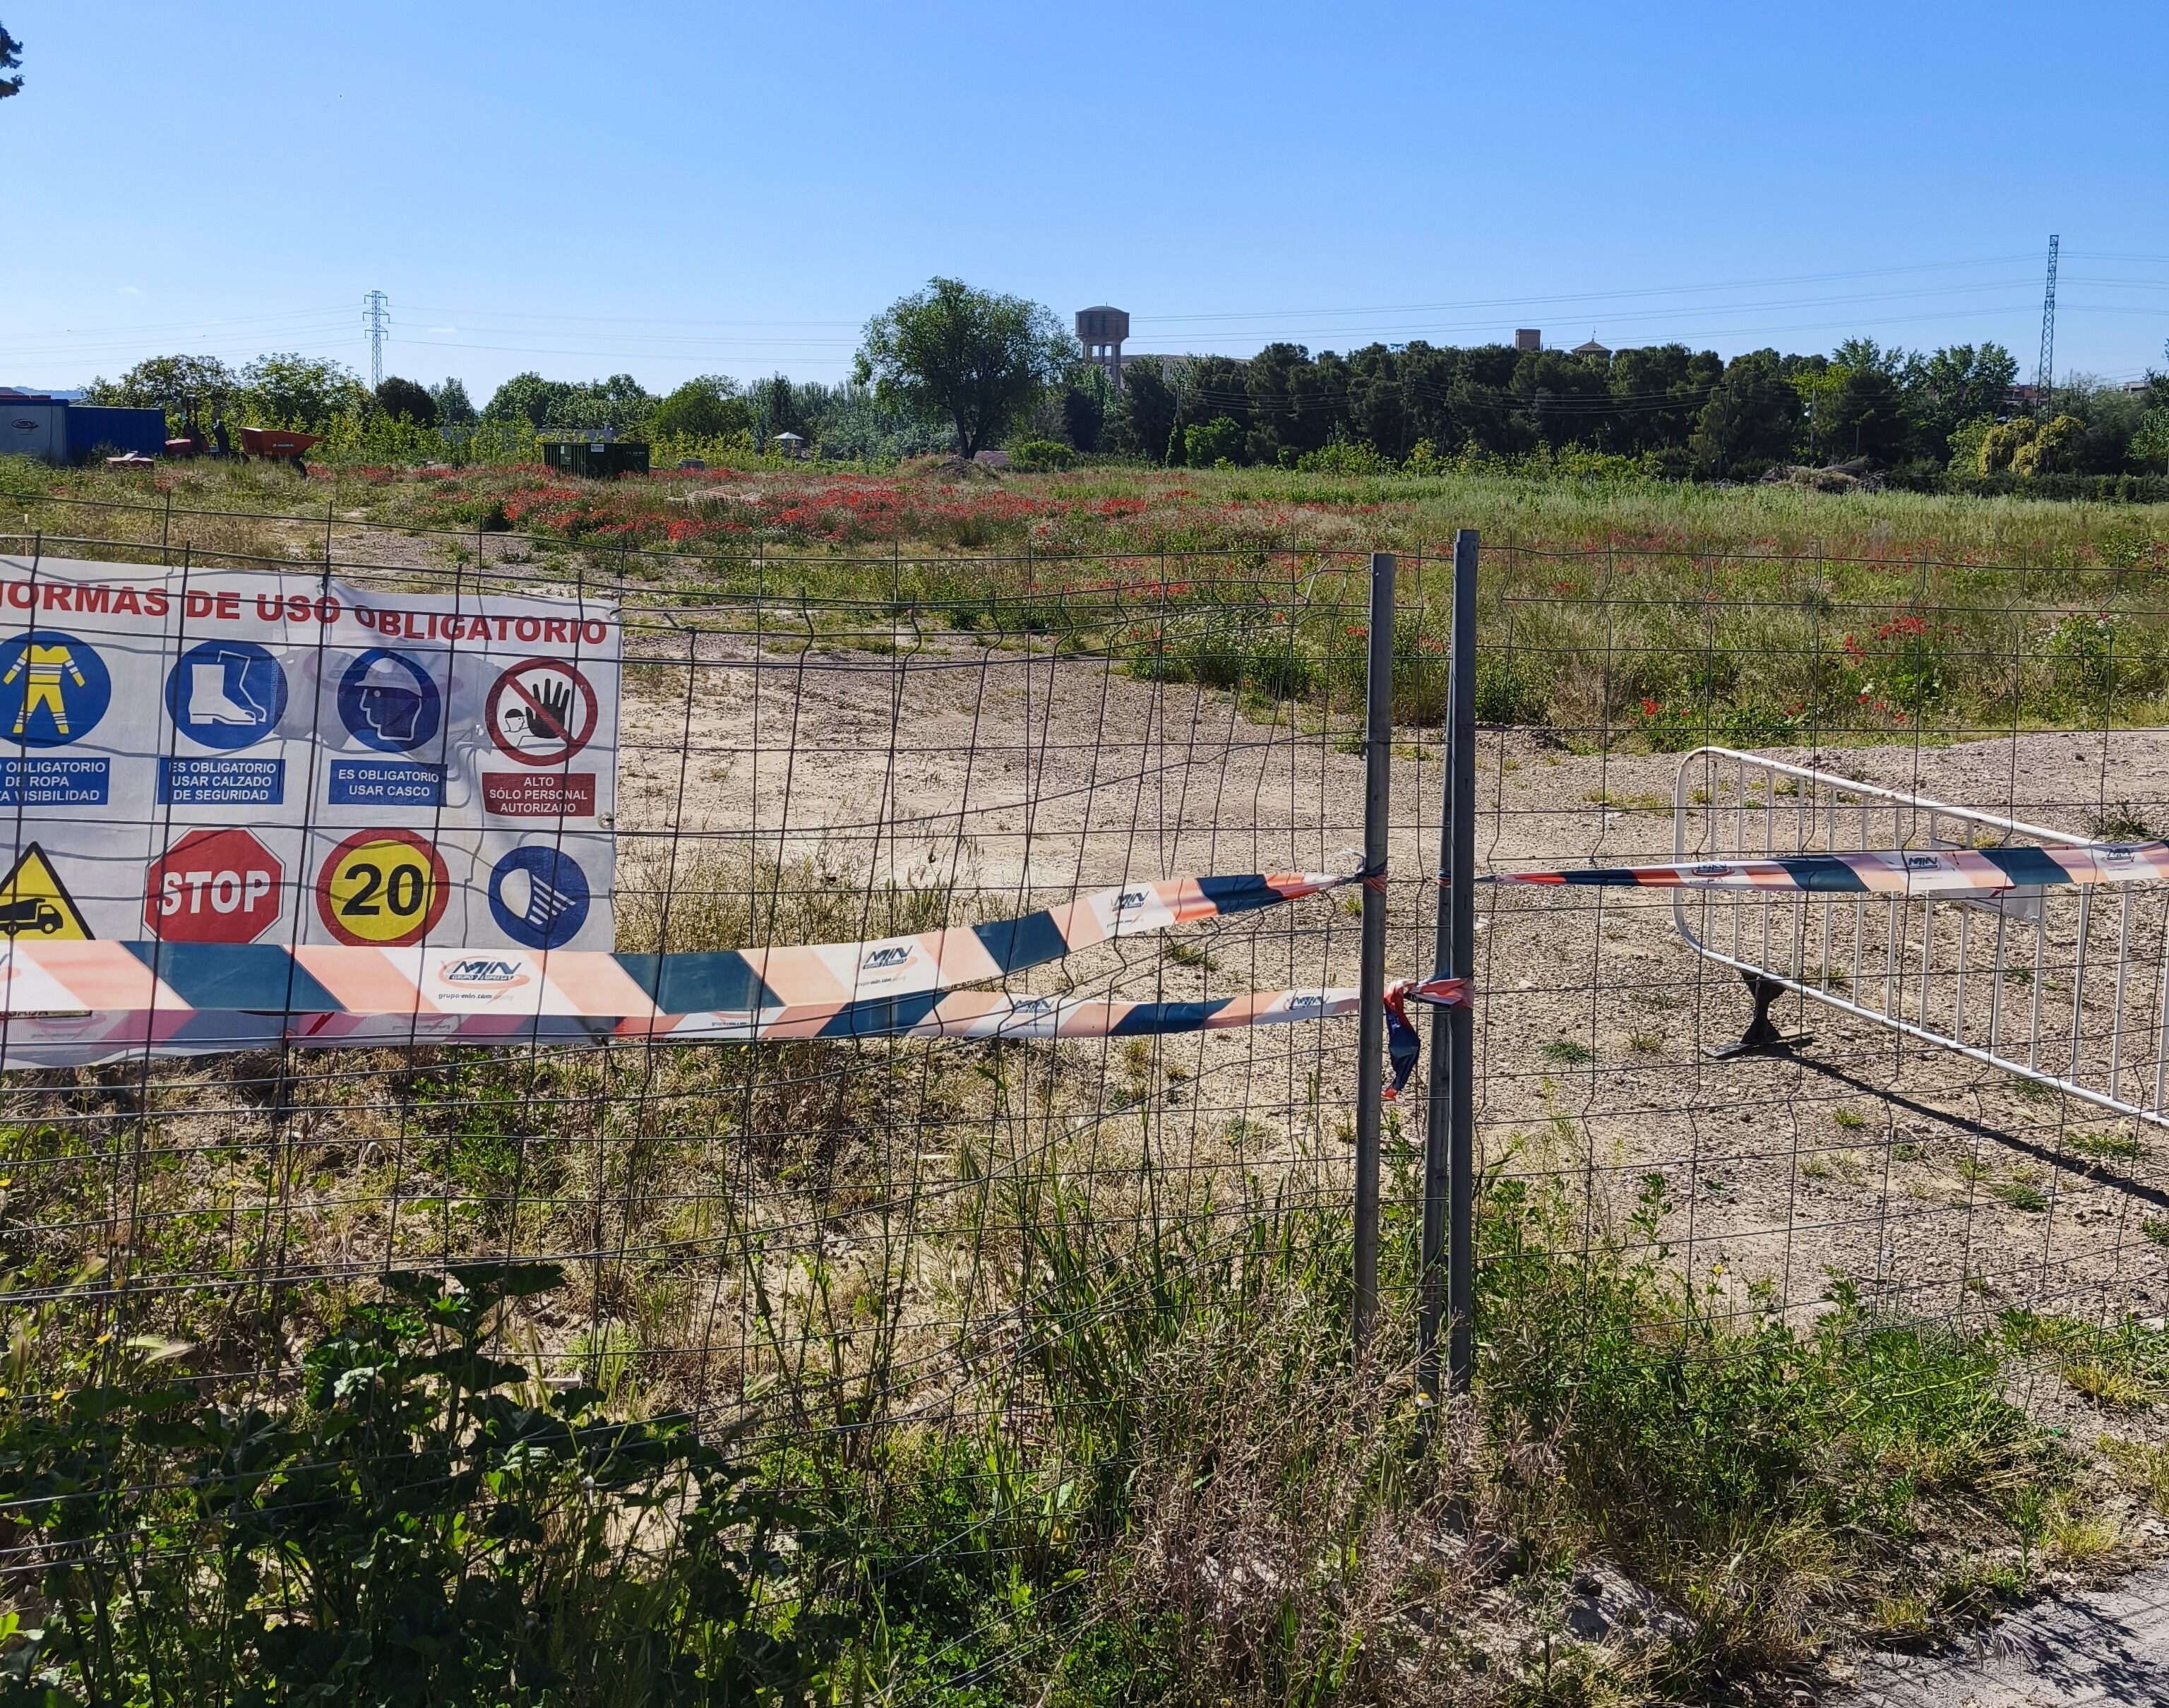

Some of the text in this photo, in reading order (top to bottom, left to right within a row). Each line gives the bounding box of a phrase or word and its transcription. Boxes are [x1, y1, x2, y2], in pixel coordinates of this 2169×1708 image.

[0, 578, 607, 645] ORMAS DE USO OBLIGATORIO
[6, 761, 106, 773] OBLIGATORIO
[169, 762, 277, 774] ES OBLIGATORIO
[29, 776, 70, 787] ROPA
[172, 775, 272, 787] USAR CALZADO
[338, 769, 439, 783] ES OBLIGATORIO
[523, 777, 554, 787] ALTO
[173, 789, 269, 801] DE SEGURIDAD
[349, 784, 430, 797] USAR CASCO
[489, 787, 588, 800] SÓLO PERSONAL
[156, 870, 271, 916] STOP
[340, 863, 425, 916] 20
[865, 945, 914, 964] MIN
[451, 960, 522, 975] MIN
